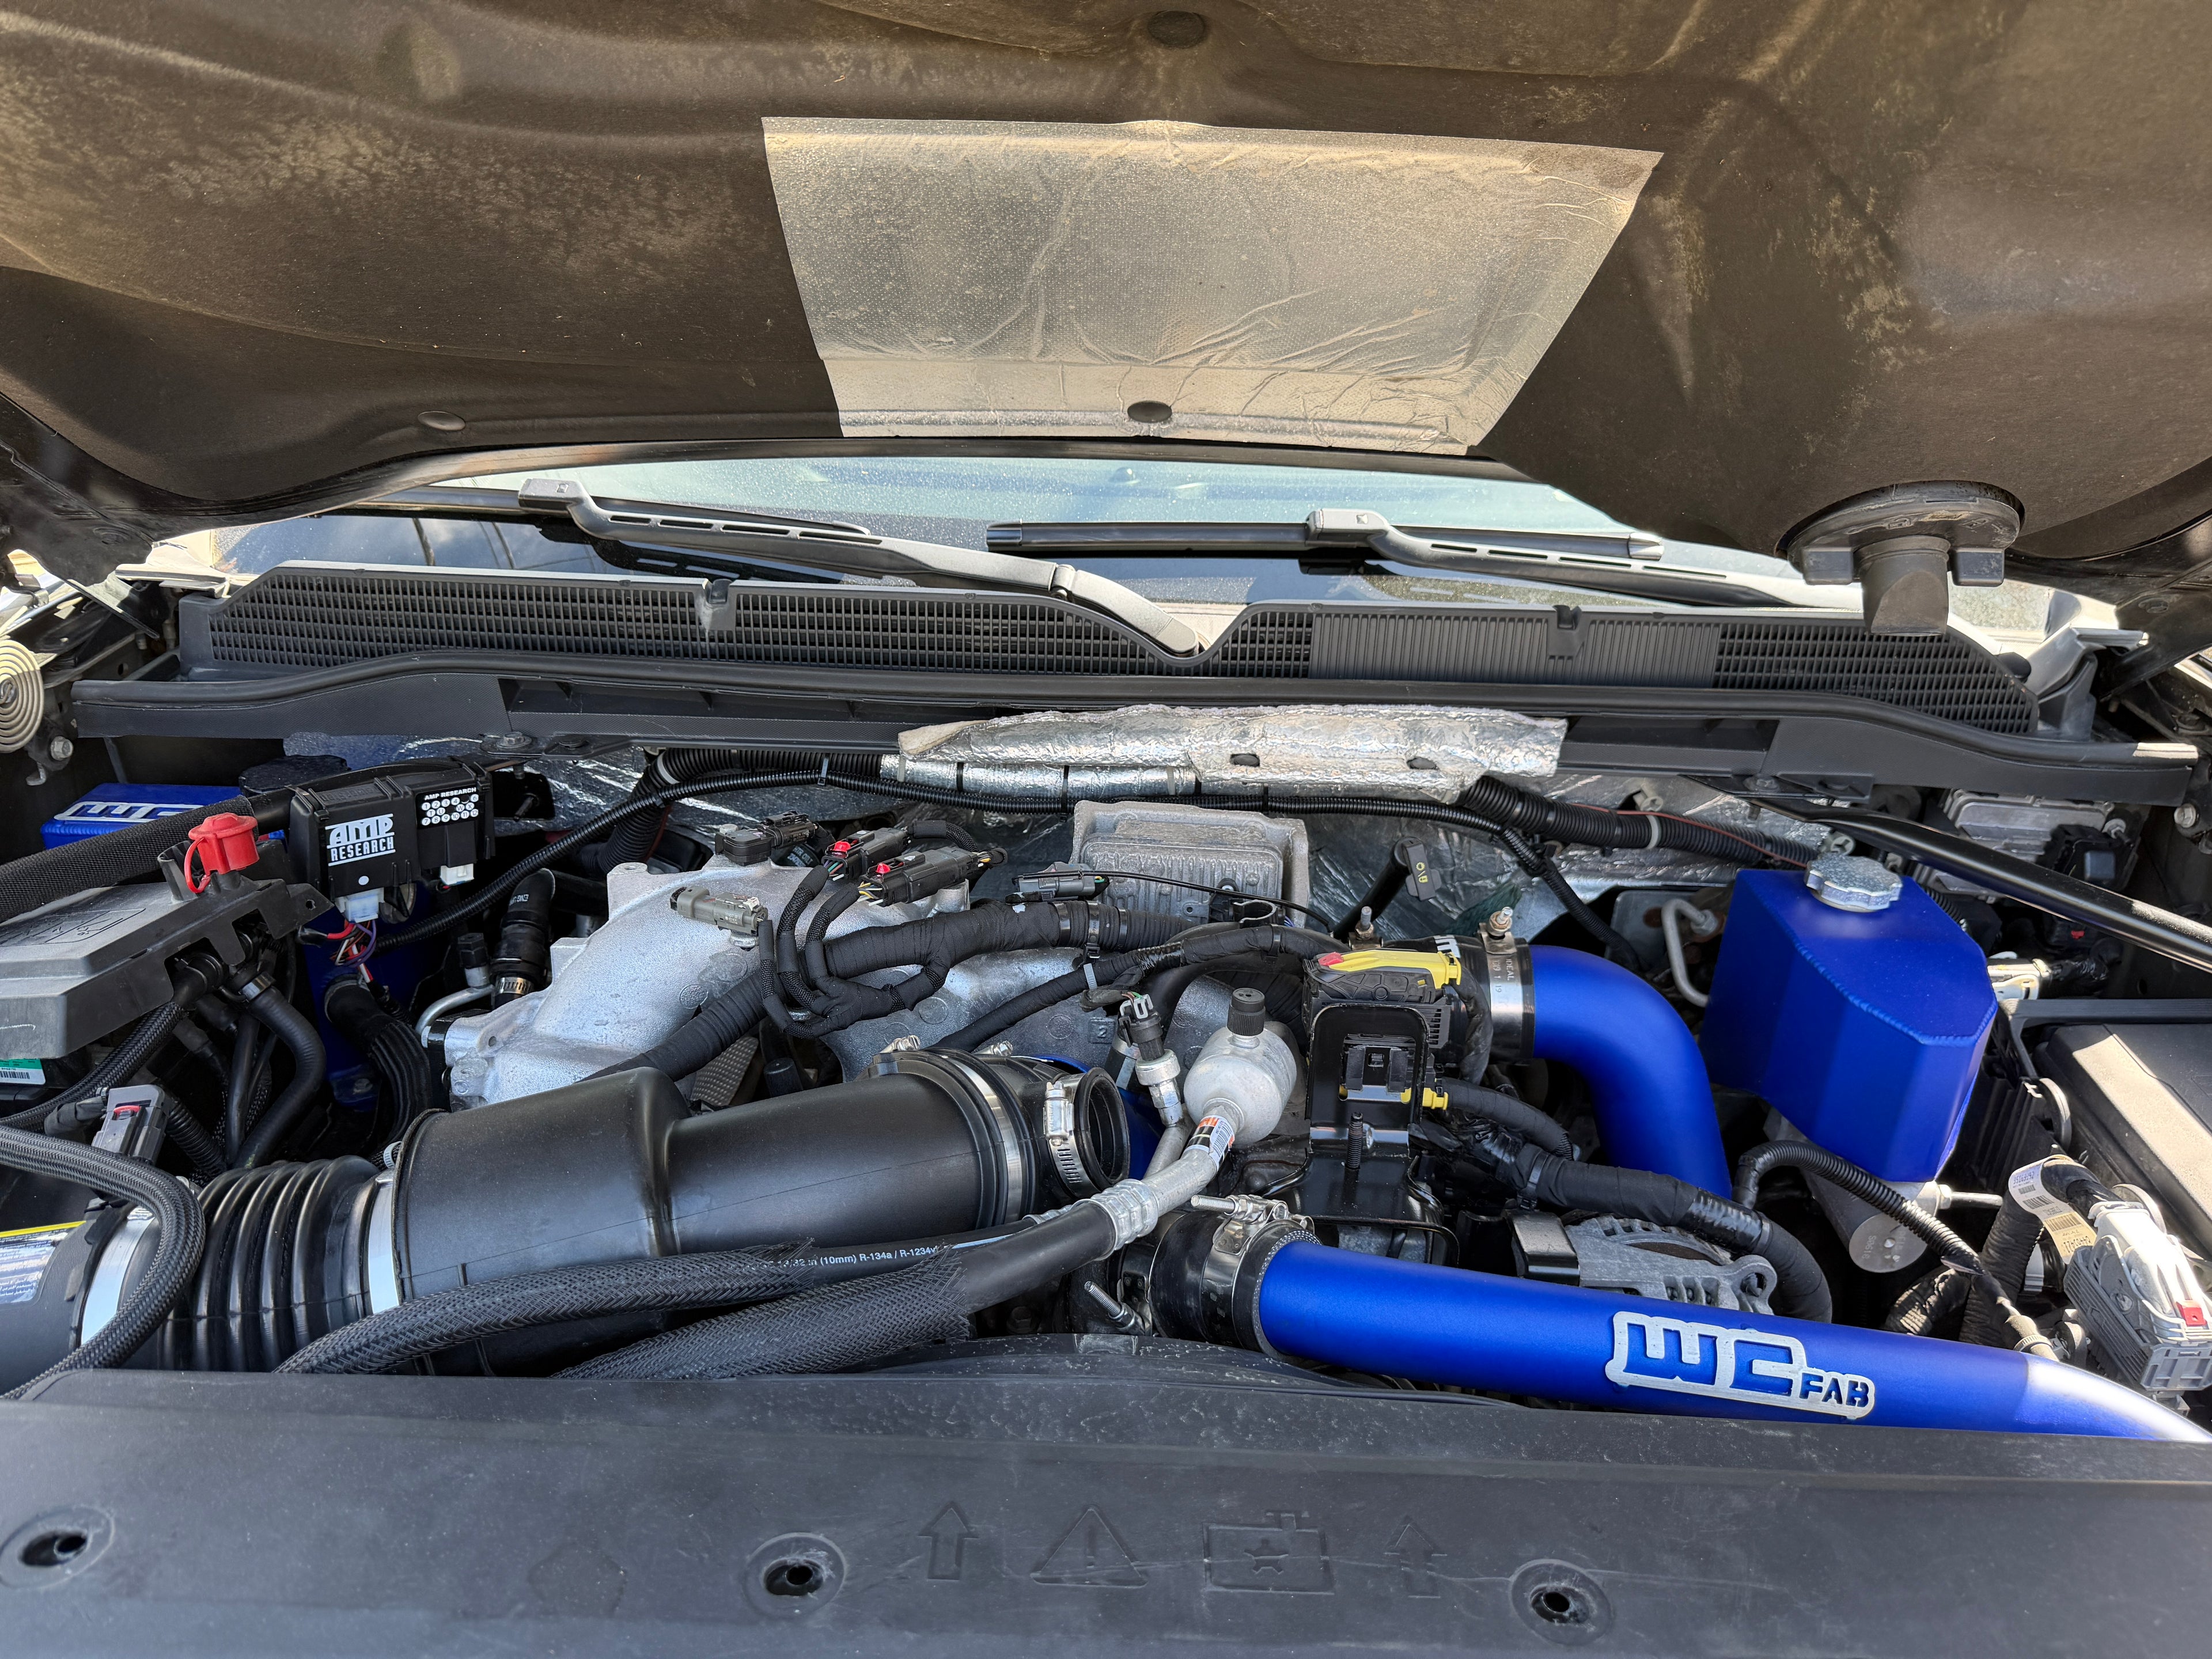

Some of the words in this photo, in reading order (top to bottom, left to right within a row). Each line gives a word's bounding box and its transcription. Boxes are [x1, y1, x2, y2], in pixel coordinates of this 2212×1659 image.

[441, 787, 477, 798] RESEARCH
[328, 816, 394, 847] AMP
[331, 836, 395, 862] RESEARCH
[1505, 959, 1515, 981] IDEAL
[820, 1254, 857, 1267] (10mm)
[859, 1252, 893, 1262] R-134a
[1798, 1372, 1870, 1409] FAB
